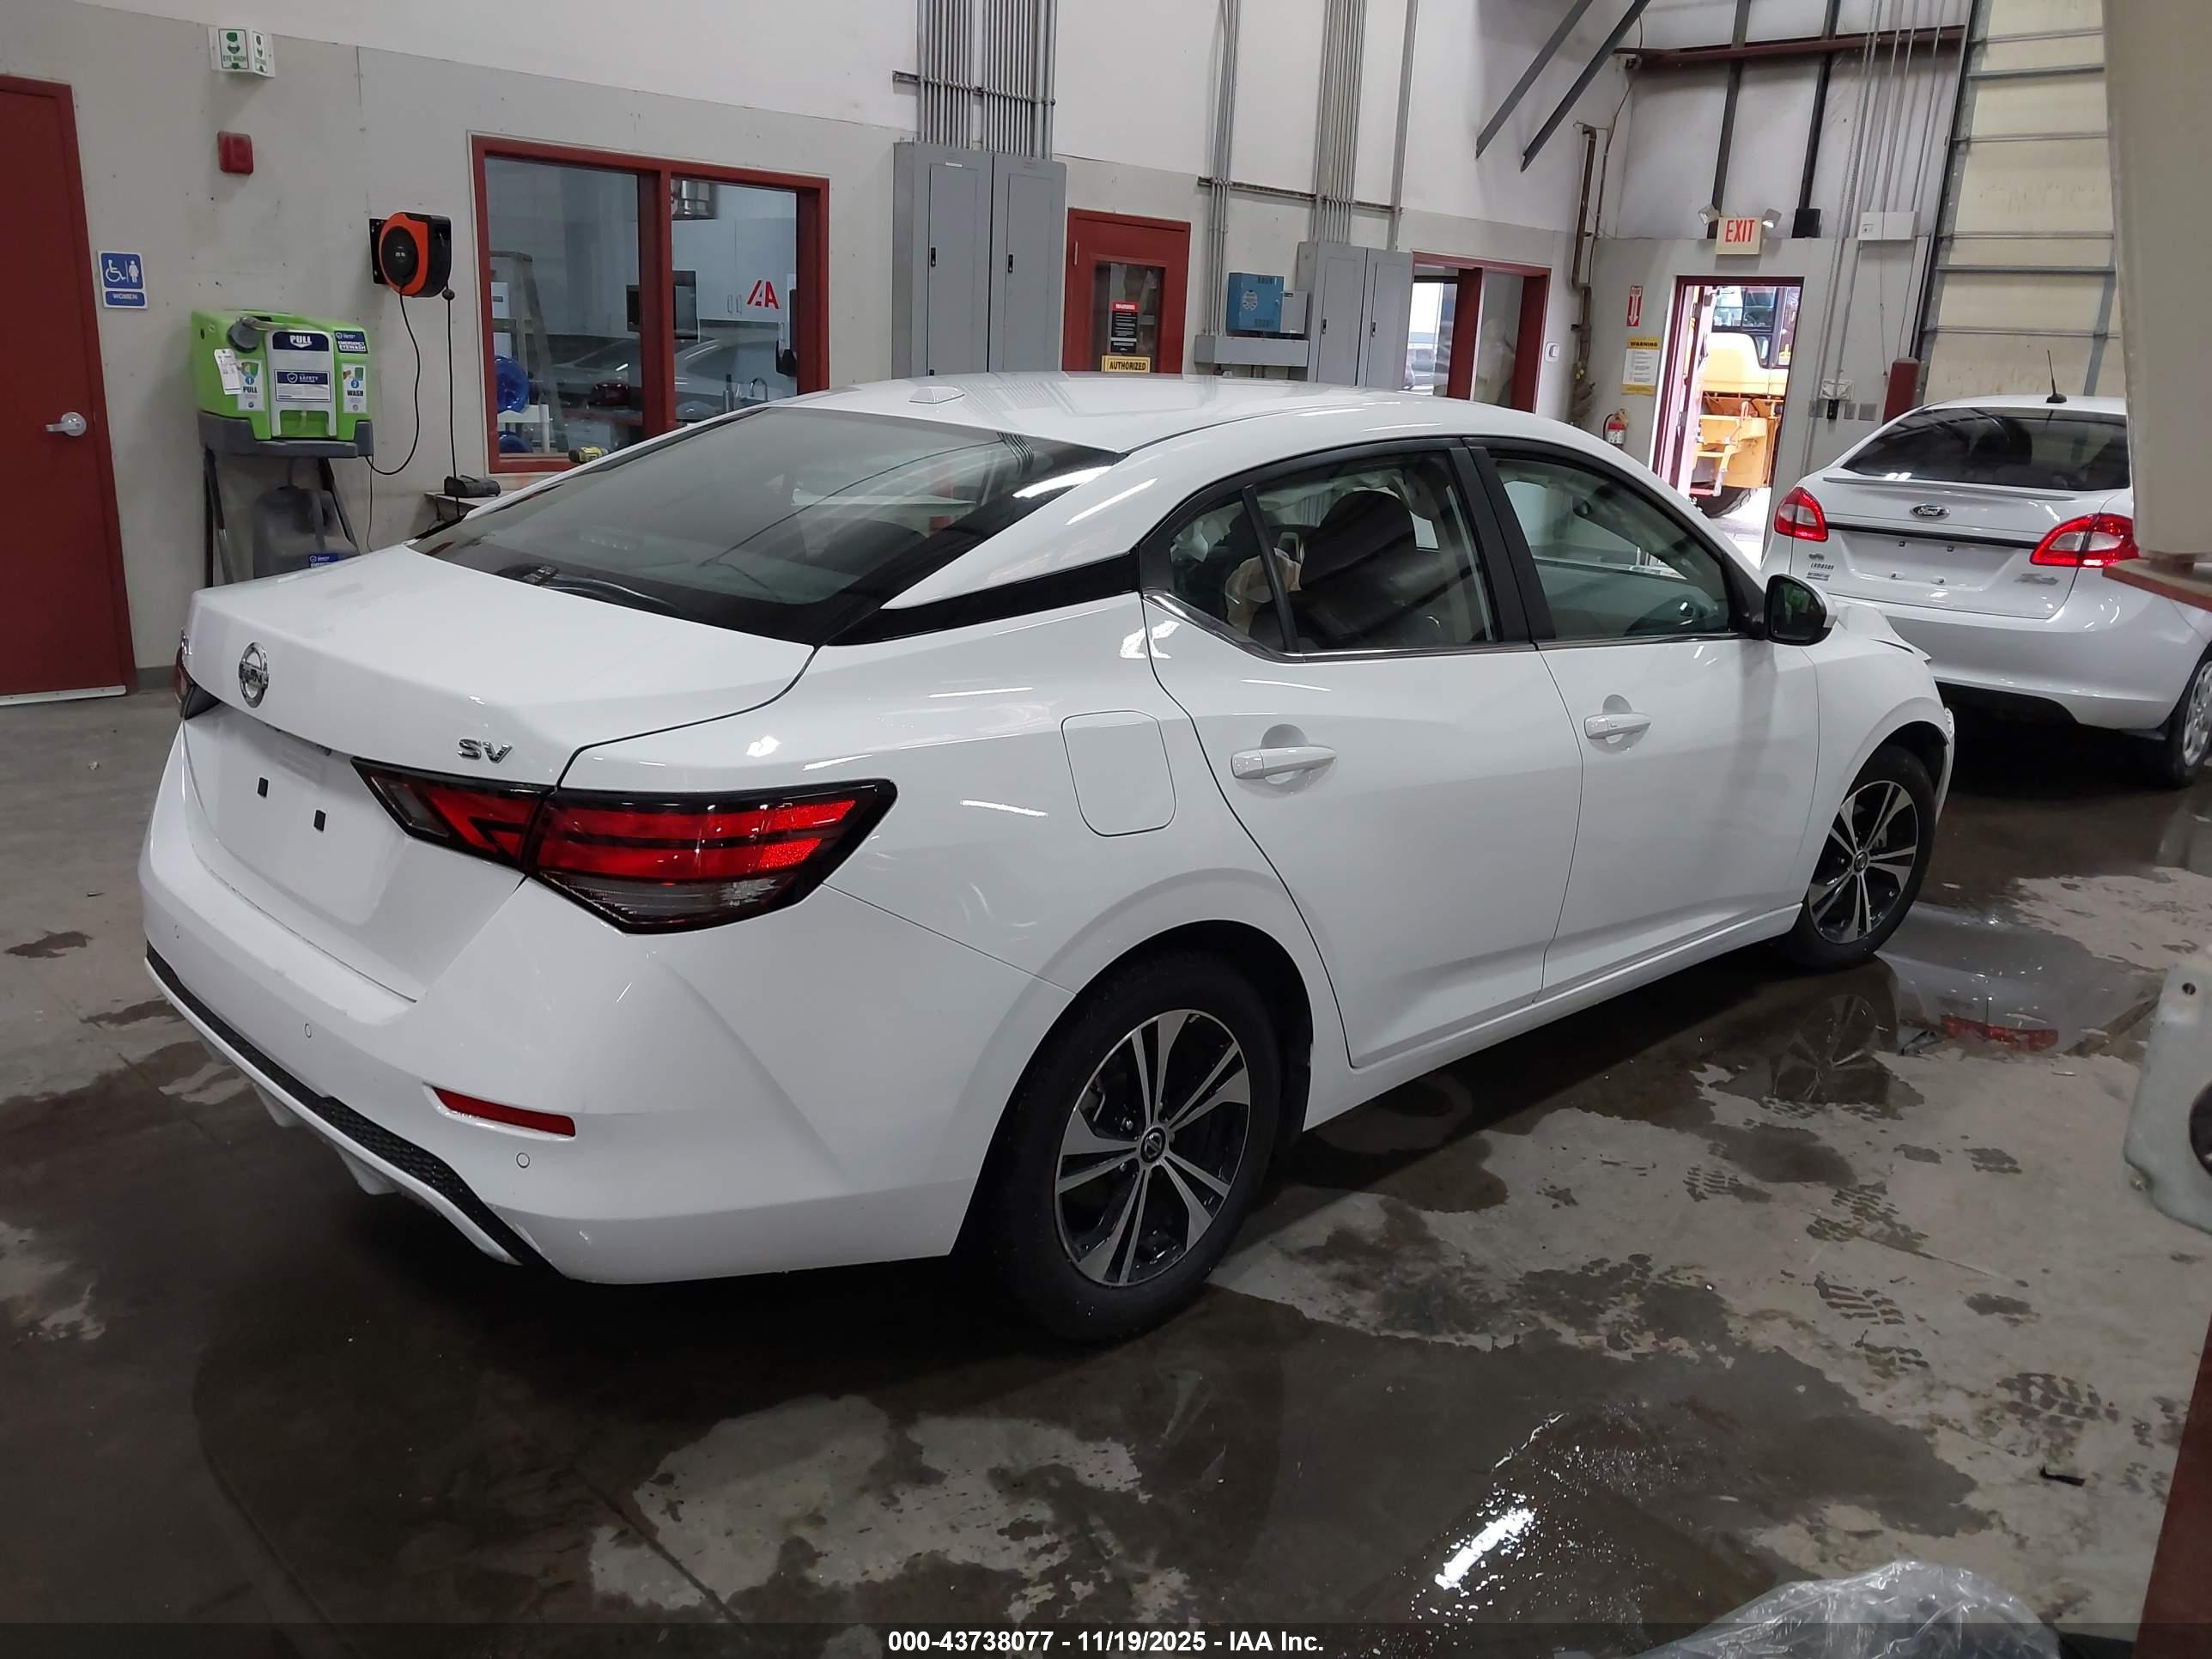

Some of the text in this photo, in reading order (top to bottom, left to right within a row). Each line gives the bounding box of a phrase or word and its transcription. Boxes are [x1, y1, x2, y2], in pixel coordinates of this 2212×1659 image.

[1725, 219, 1755, 242] EXIT
[289, 335, 313, 344] PULL
[1109, 361, 1146, 371] AUTHORIZED
[457, 738, 514, 763] SV
